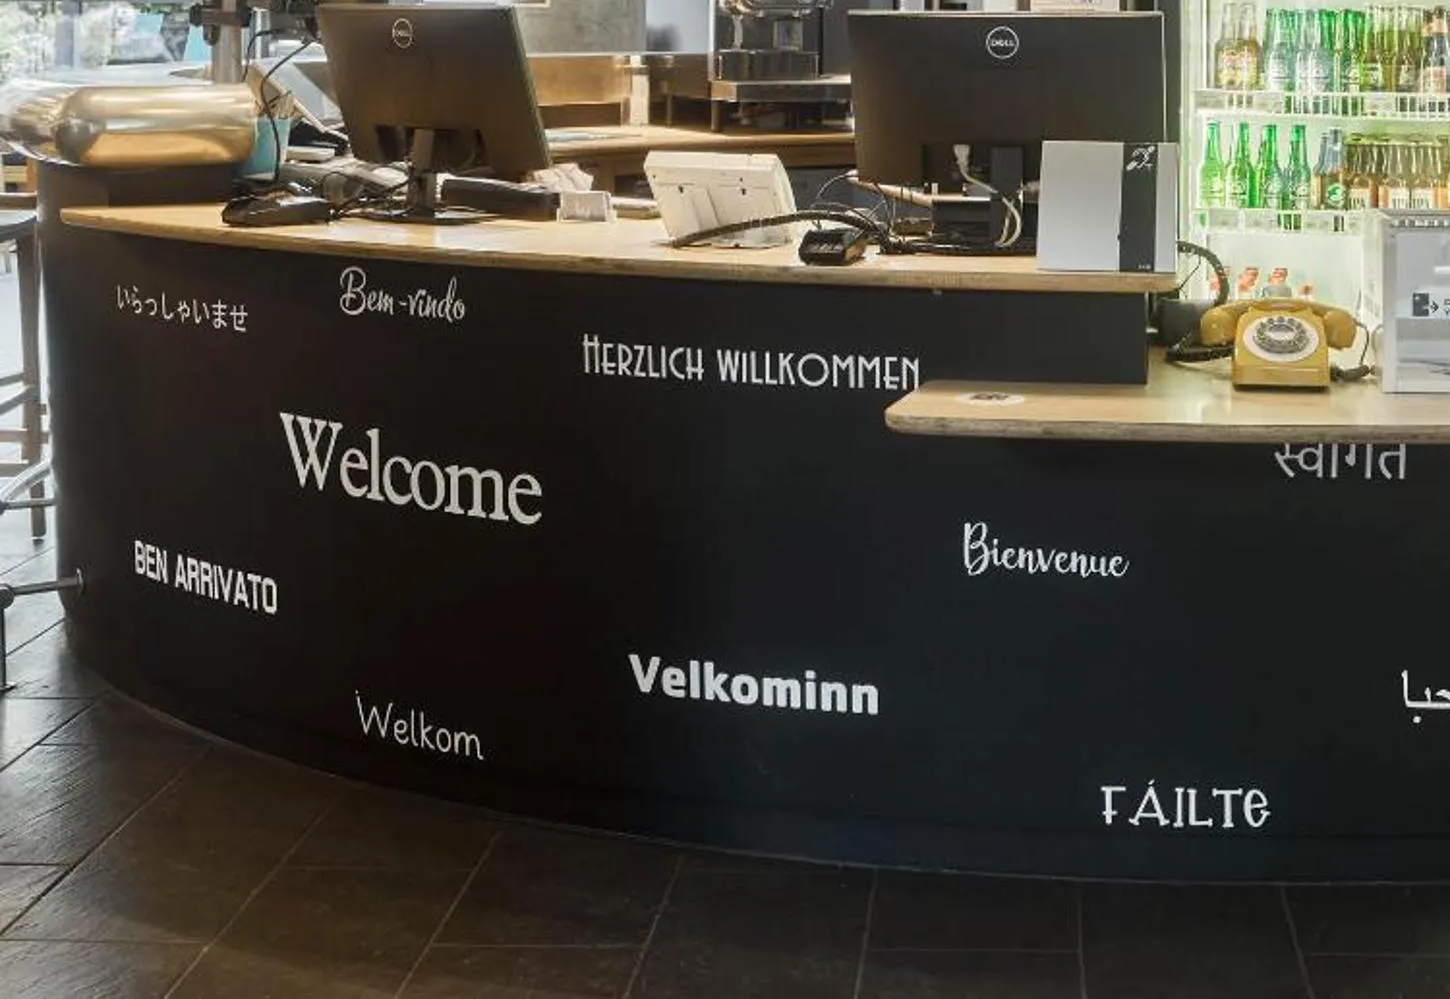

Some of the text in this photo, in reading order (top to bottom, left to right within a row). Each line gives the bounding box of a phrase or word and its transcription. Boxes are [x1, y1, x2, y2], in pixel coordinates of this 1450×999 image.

[116, 284, 249, 333] いらっしゃいませ
[339, 266, 466, 323] Bem-vindo
[582, 333, 921, 392] HERZLICH WILLKOMMEN
[279, 411, 543, 525] Welcome
[134, 539, 278, 615] BEN ARRIVATO
[963, 521, 1130, 579] Bienvenue
[628, 653, 879, 716] Velkominn
[355, 690, 484, 760] Welkom
